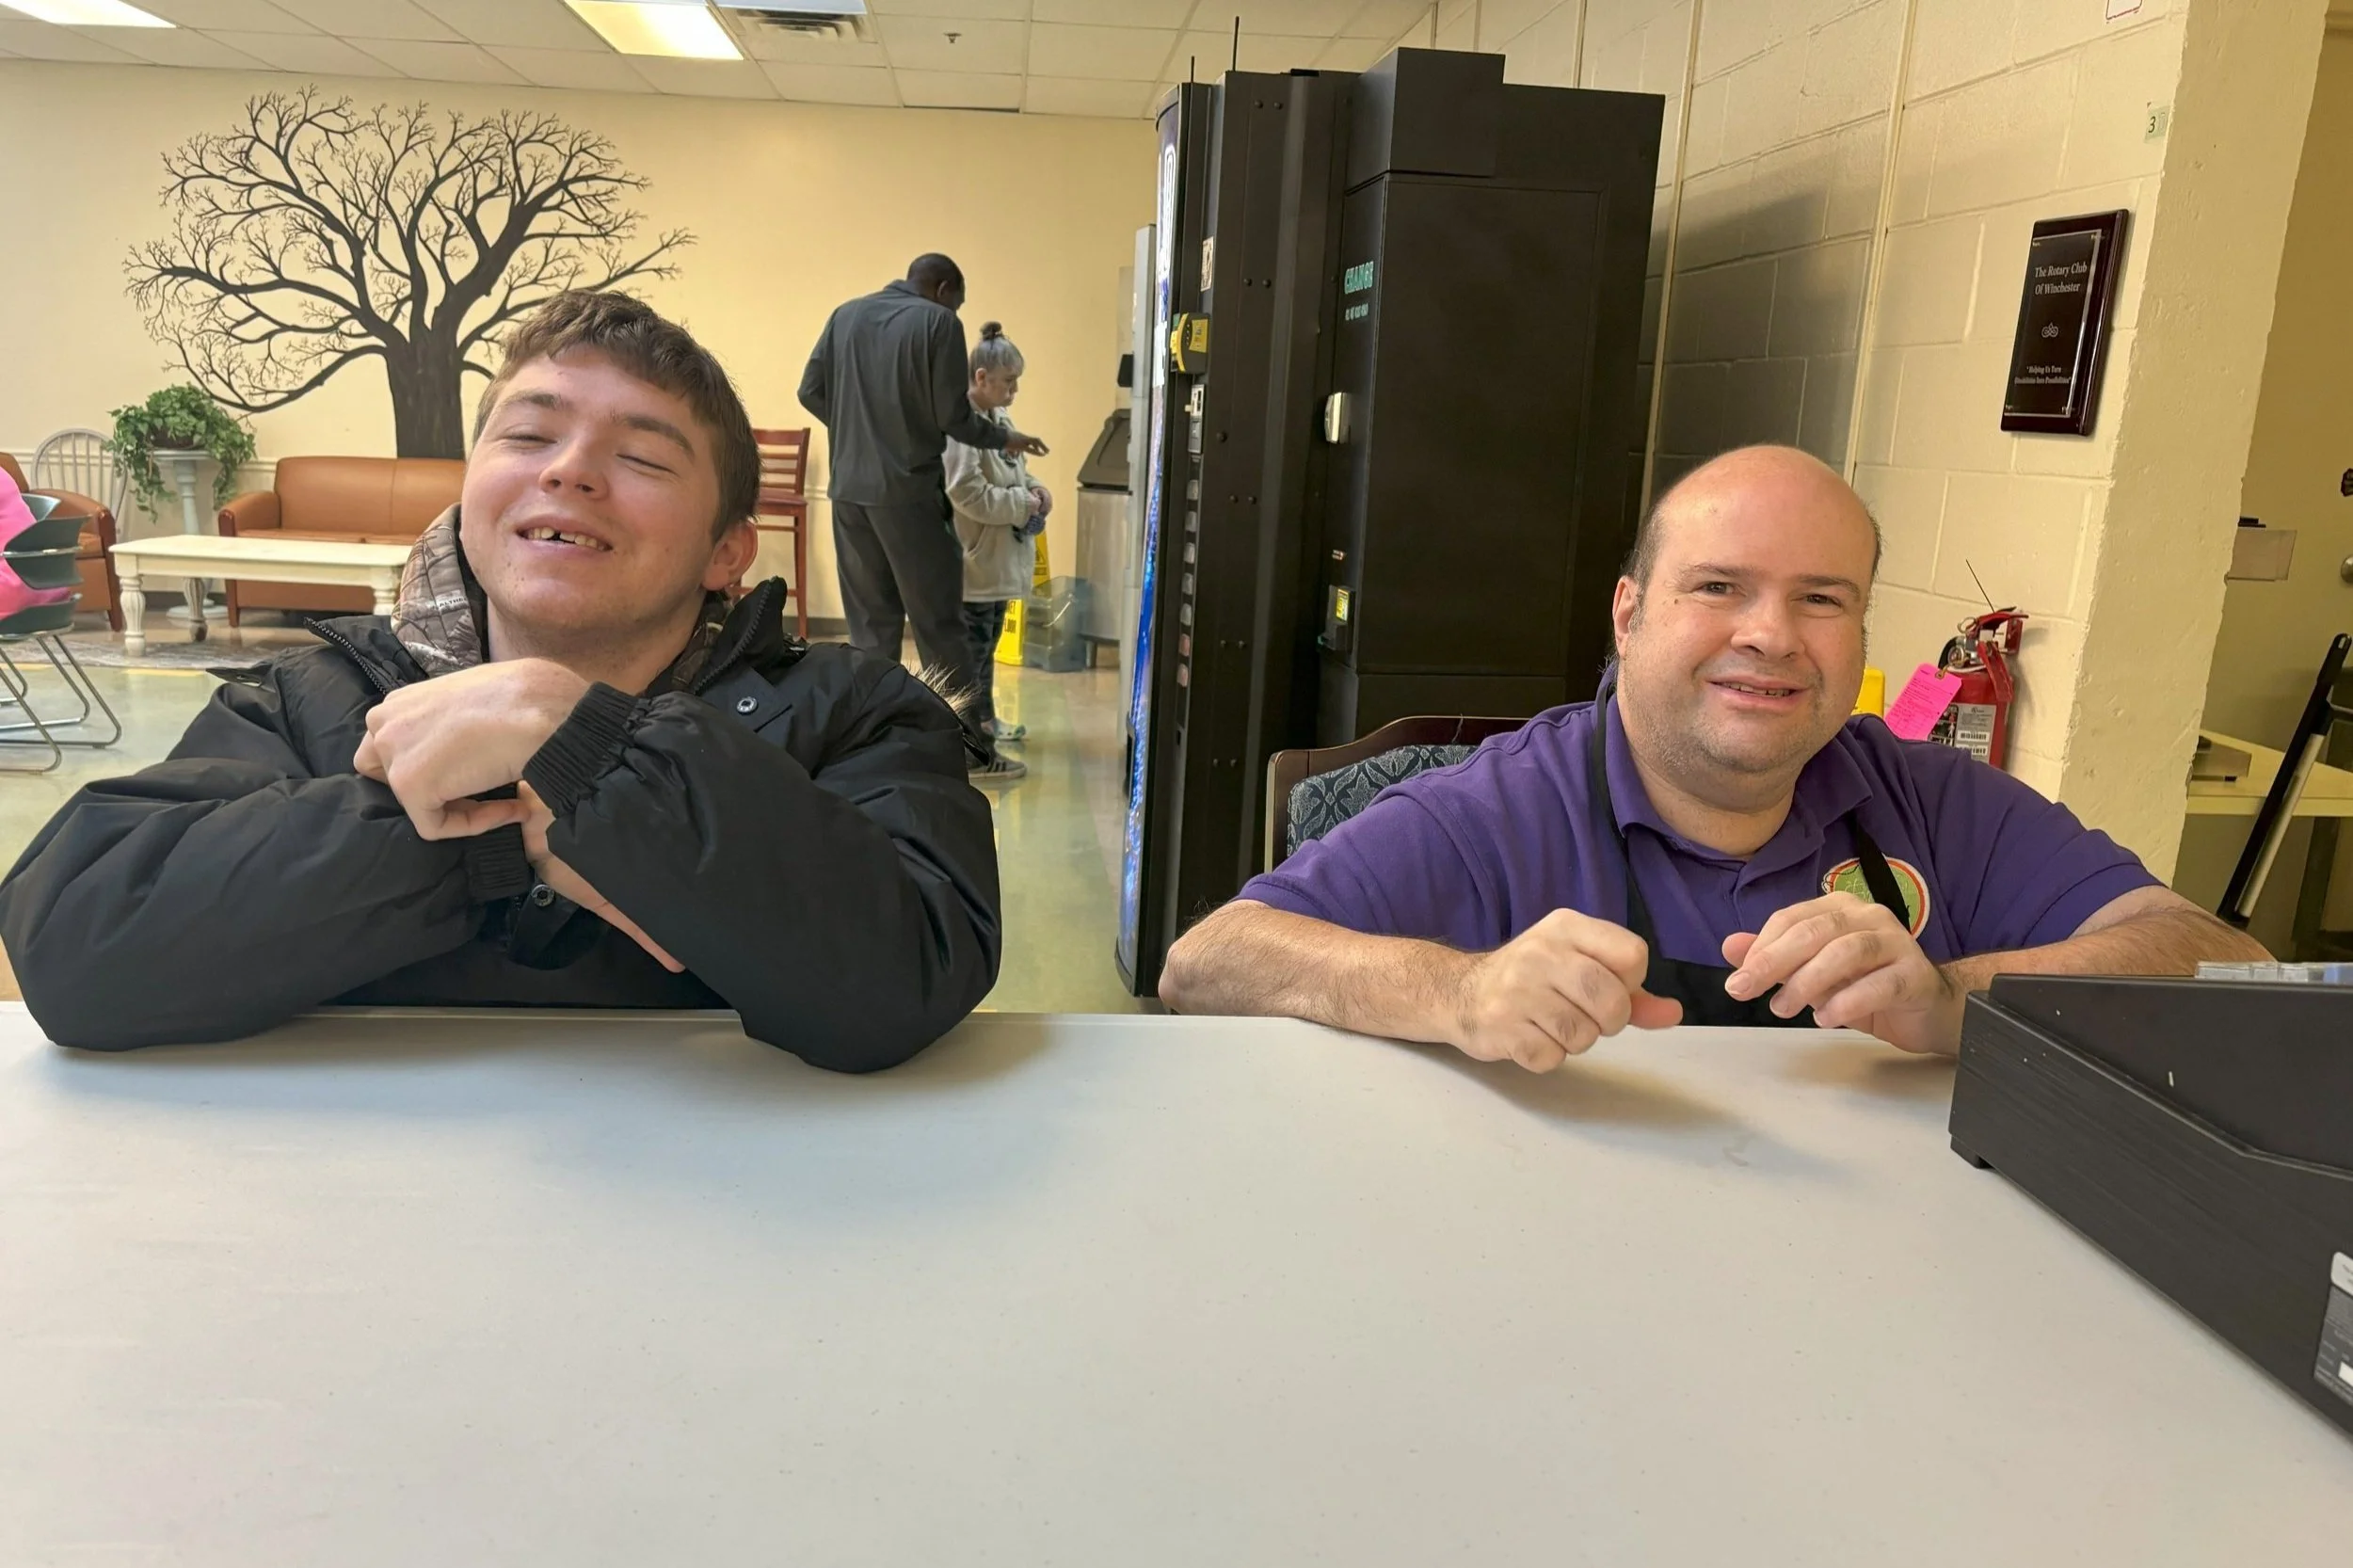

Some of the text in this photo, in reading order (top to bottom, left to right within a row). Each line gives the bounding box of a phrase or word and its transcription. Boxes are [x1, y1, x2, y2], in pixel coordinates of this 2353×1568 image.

[1344, 261, 1374, 295] CHANGE
[2035, 261, 2088, 278] The Rotary Club
[2035, 281, 2081, 296] Of Winchester
